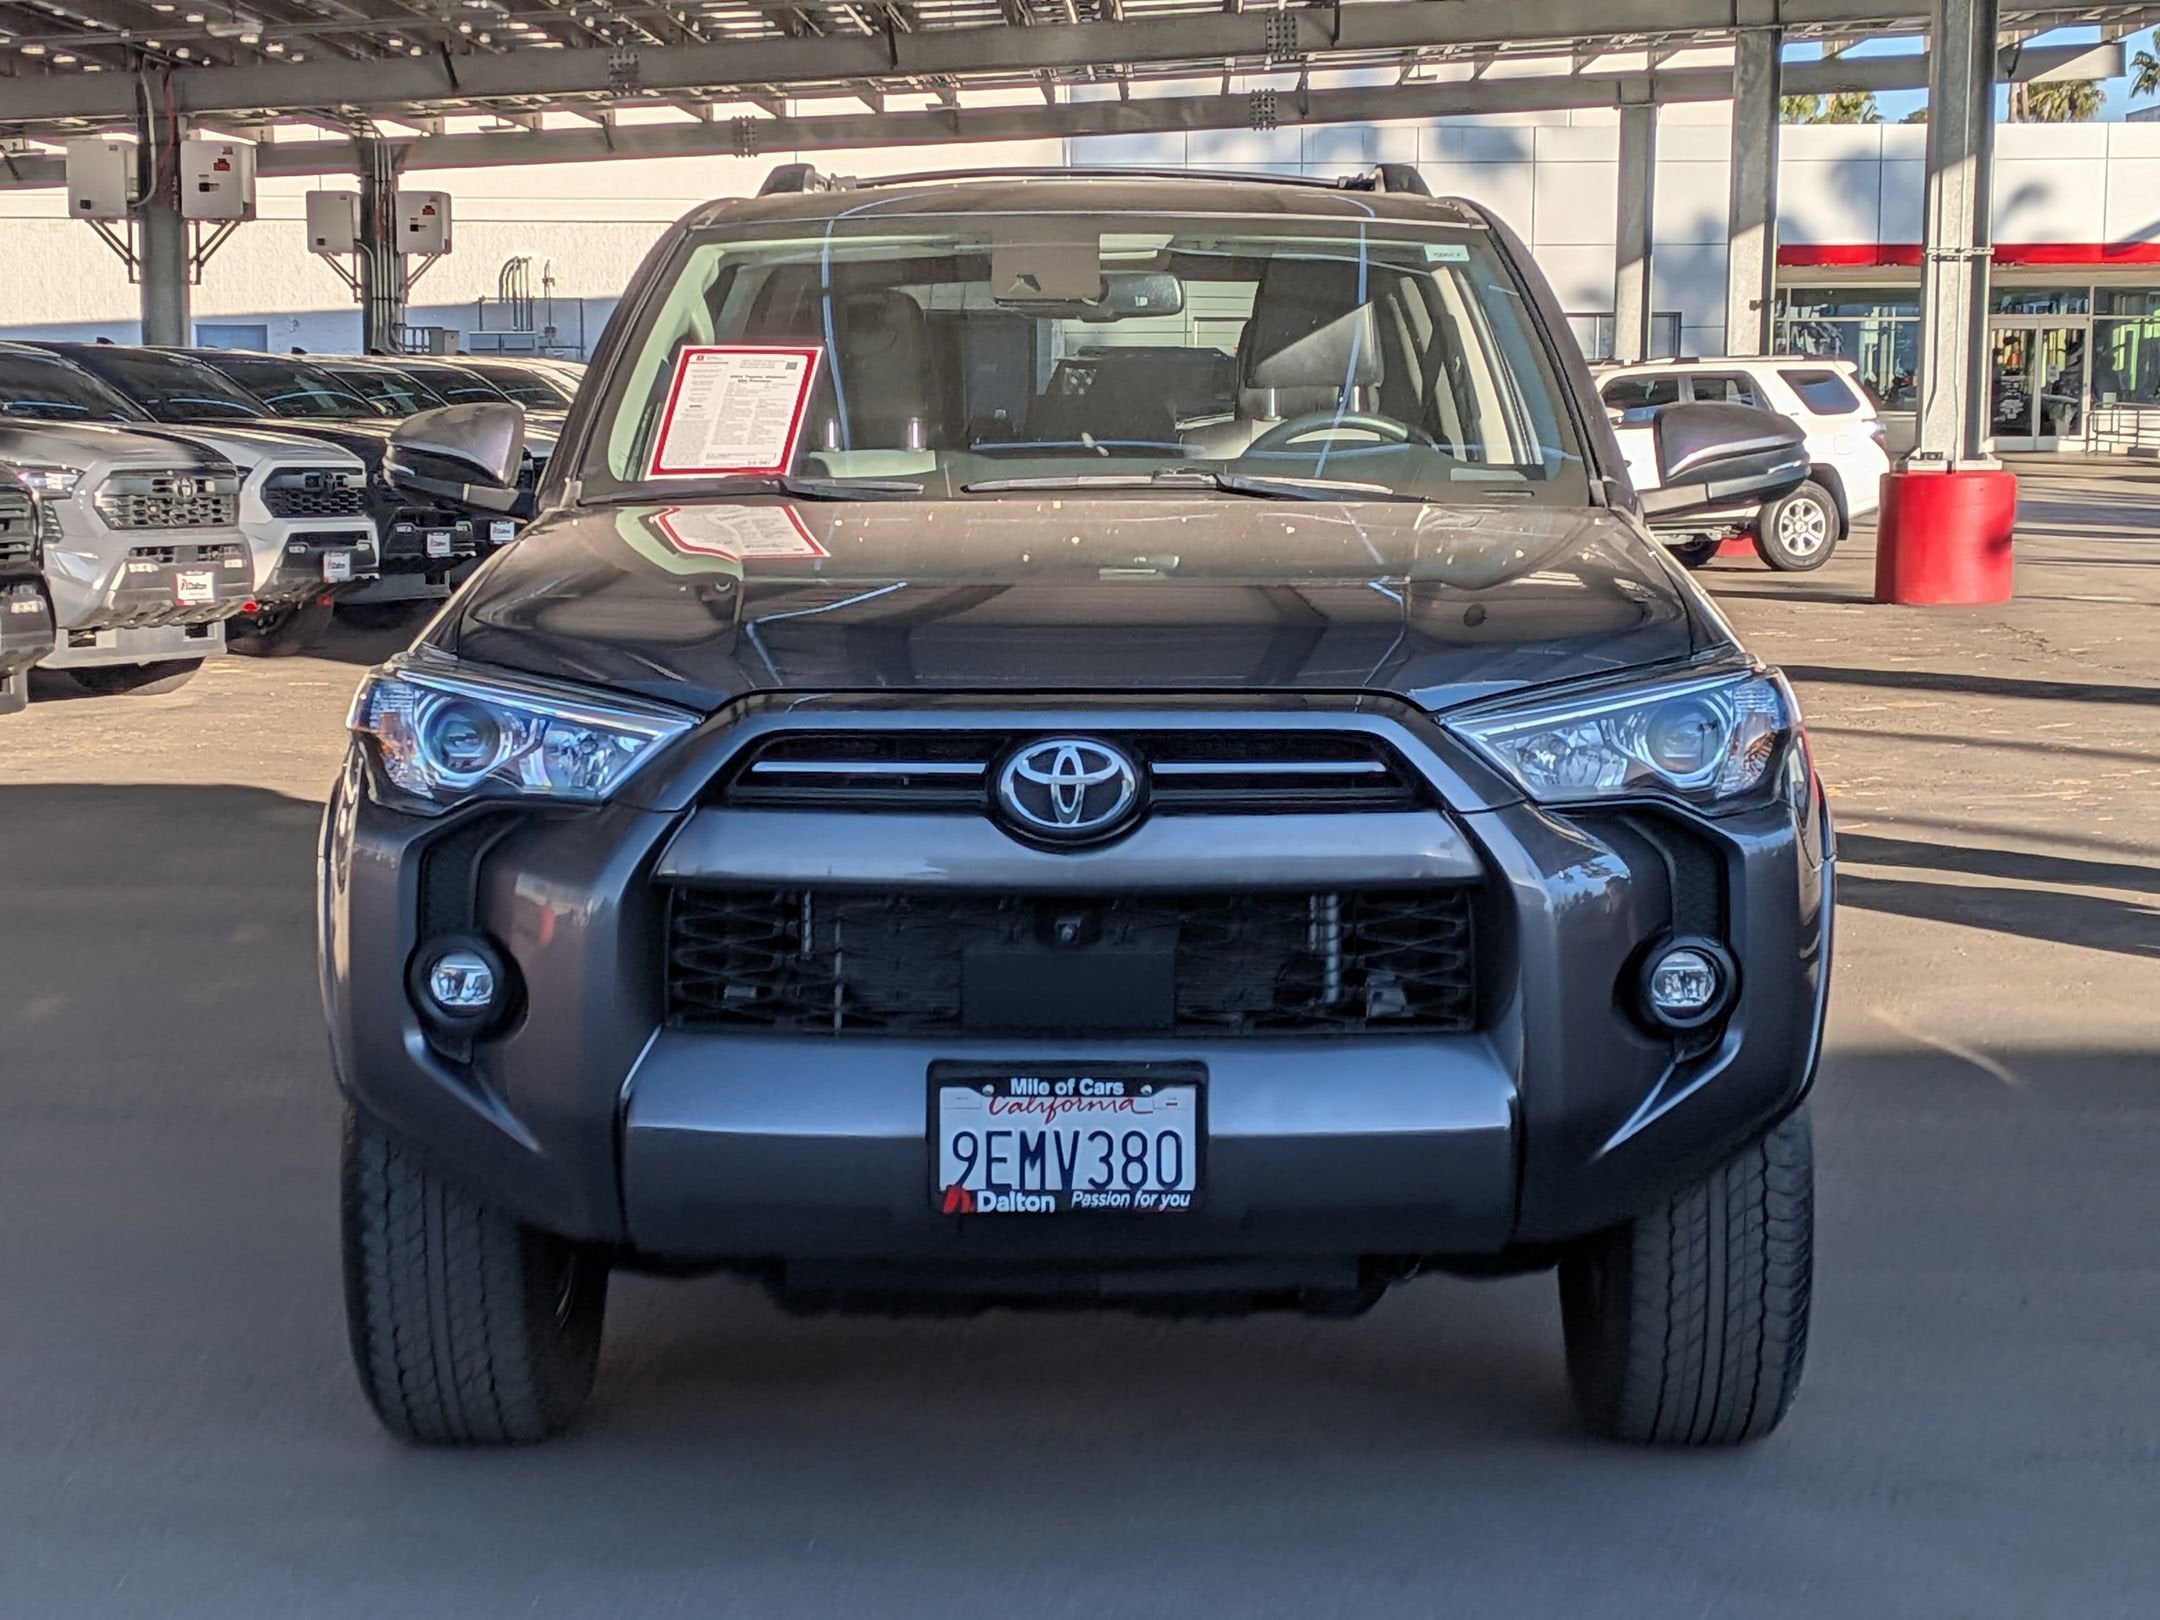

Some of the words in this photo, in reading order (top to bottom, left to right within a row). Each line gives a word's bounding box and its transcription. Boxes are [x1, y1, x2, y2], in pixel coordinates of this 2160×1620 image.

[1010, 1078, 1050, 1095] Mile
[1054, 1078, 1075, 1095] of
[1079, 1078, 1124, 1095] Cars
[988, 1096, 1153, 1125] California
[952, 1130, 1182, 1191] 9EMV380
[977, 1190, 1056, 1213] Dalton
[1071, 1190, 1131, 1208] Passion
[1134, 1190, 1159, 1208] for
[1158, 1194, 1190, 1211] you
